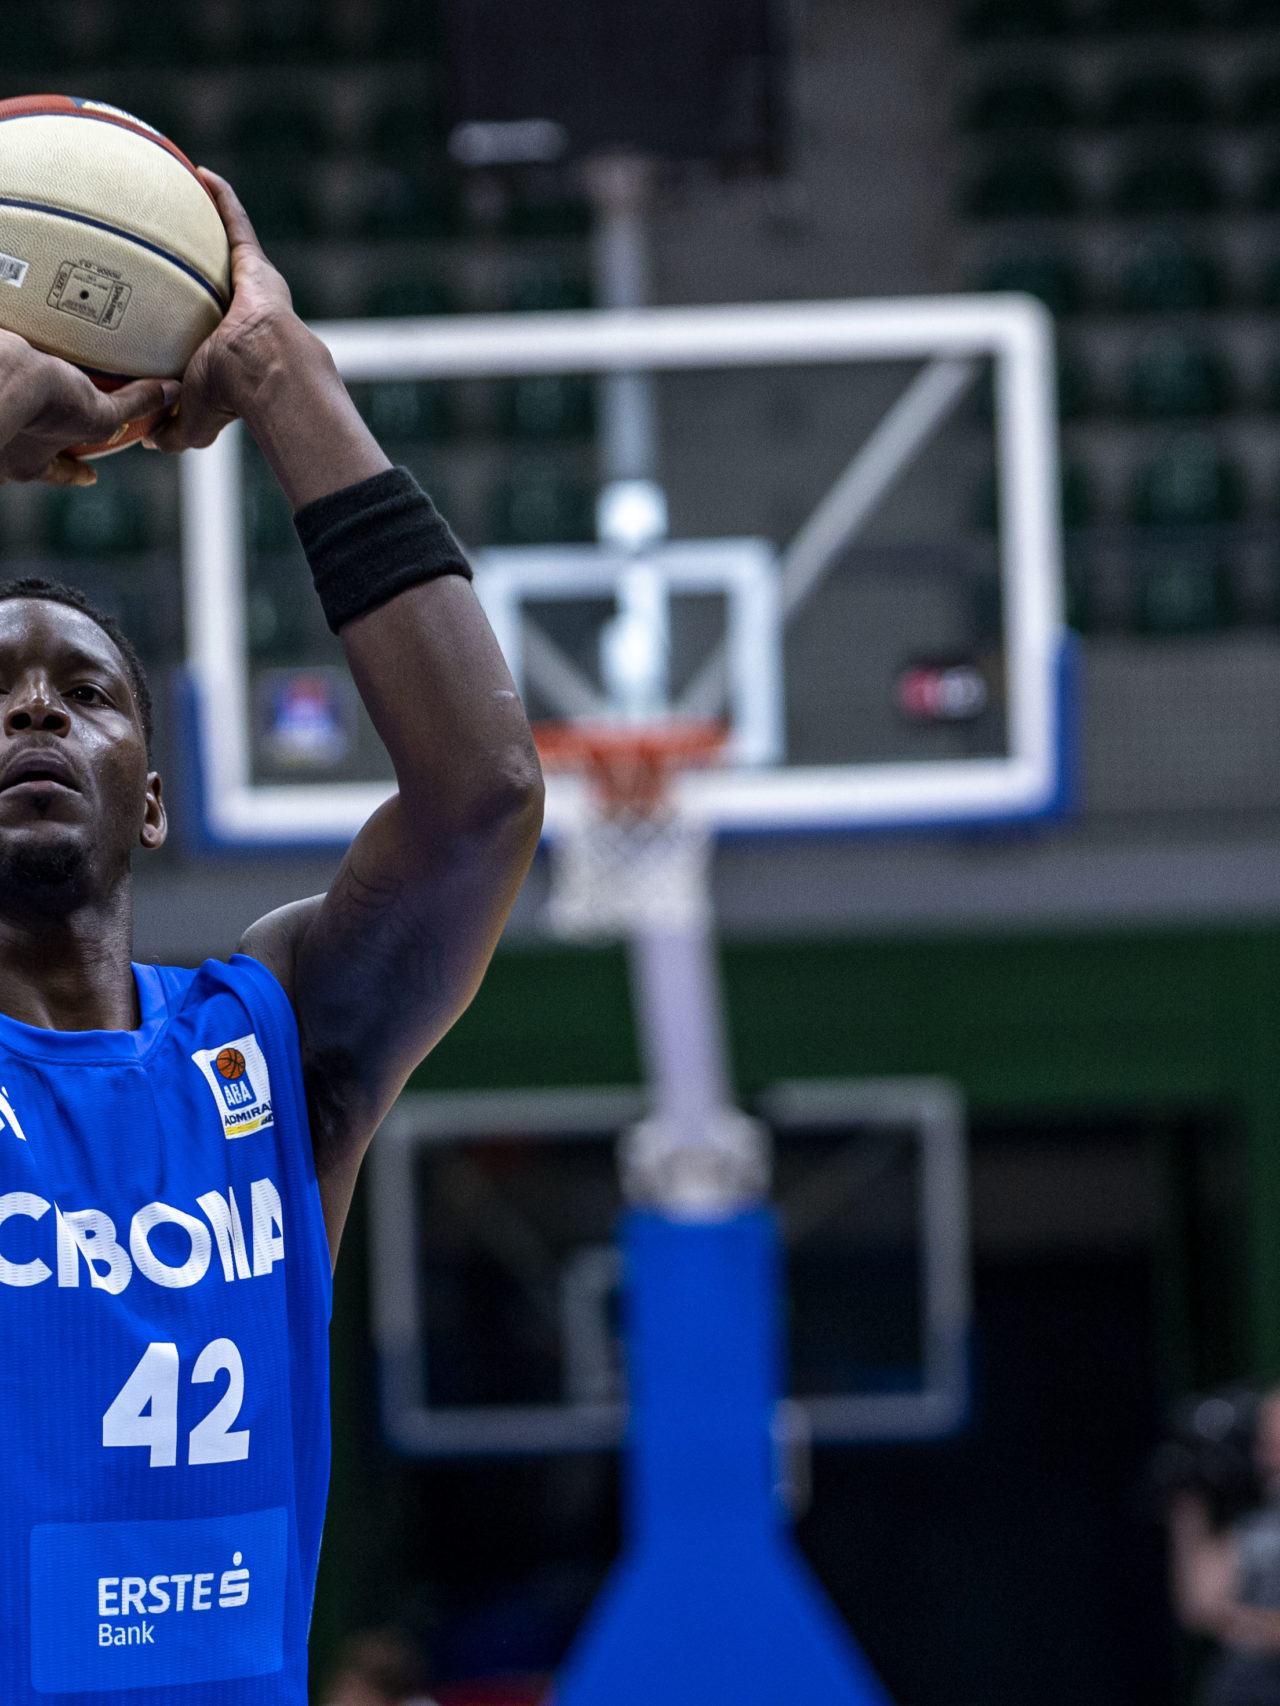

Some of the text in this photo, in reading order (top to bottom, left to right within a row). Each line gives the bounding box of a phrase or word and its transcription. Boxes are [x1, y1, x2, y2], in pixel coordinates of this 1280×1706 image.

[55, 271, 68, 291] SIZE
[223, 1080, 253, 1107] ABA
[102, 1337, 251, 1468] 42
[98, 1572, 215, 1617] ERSTE
[98, 1620, 155, 1647] Bank
